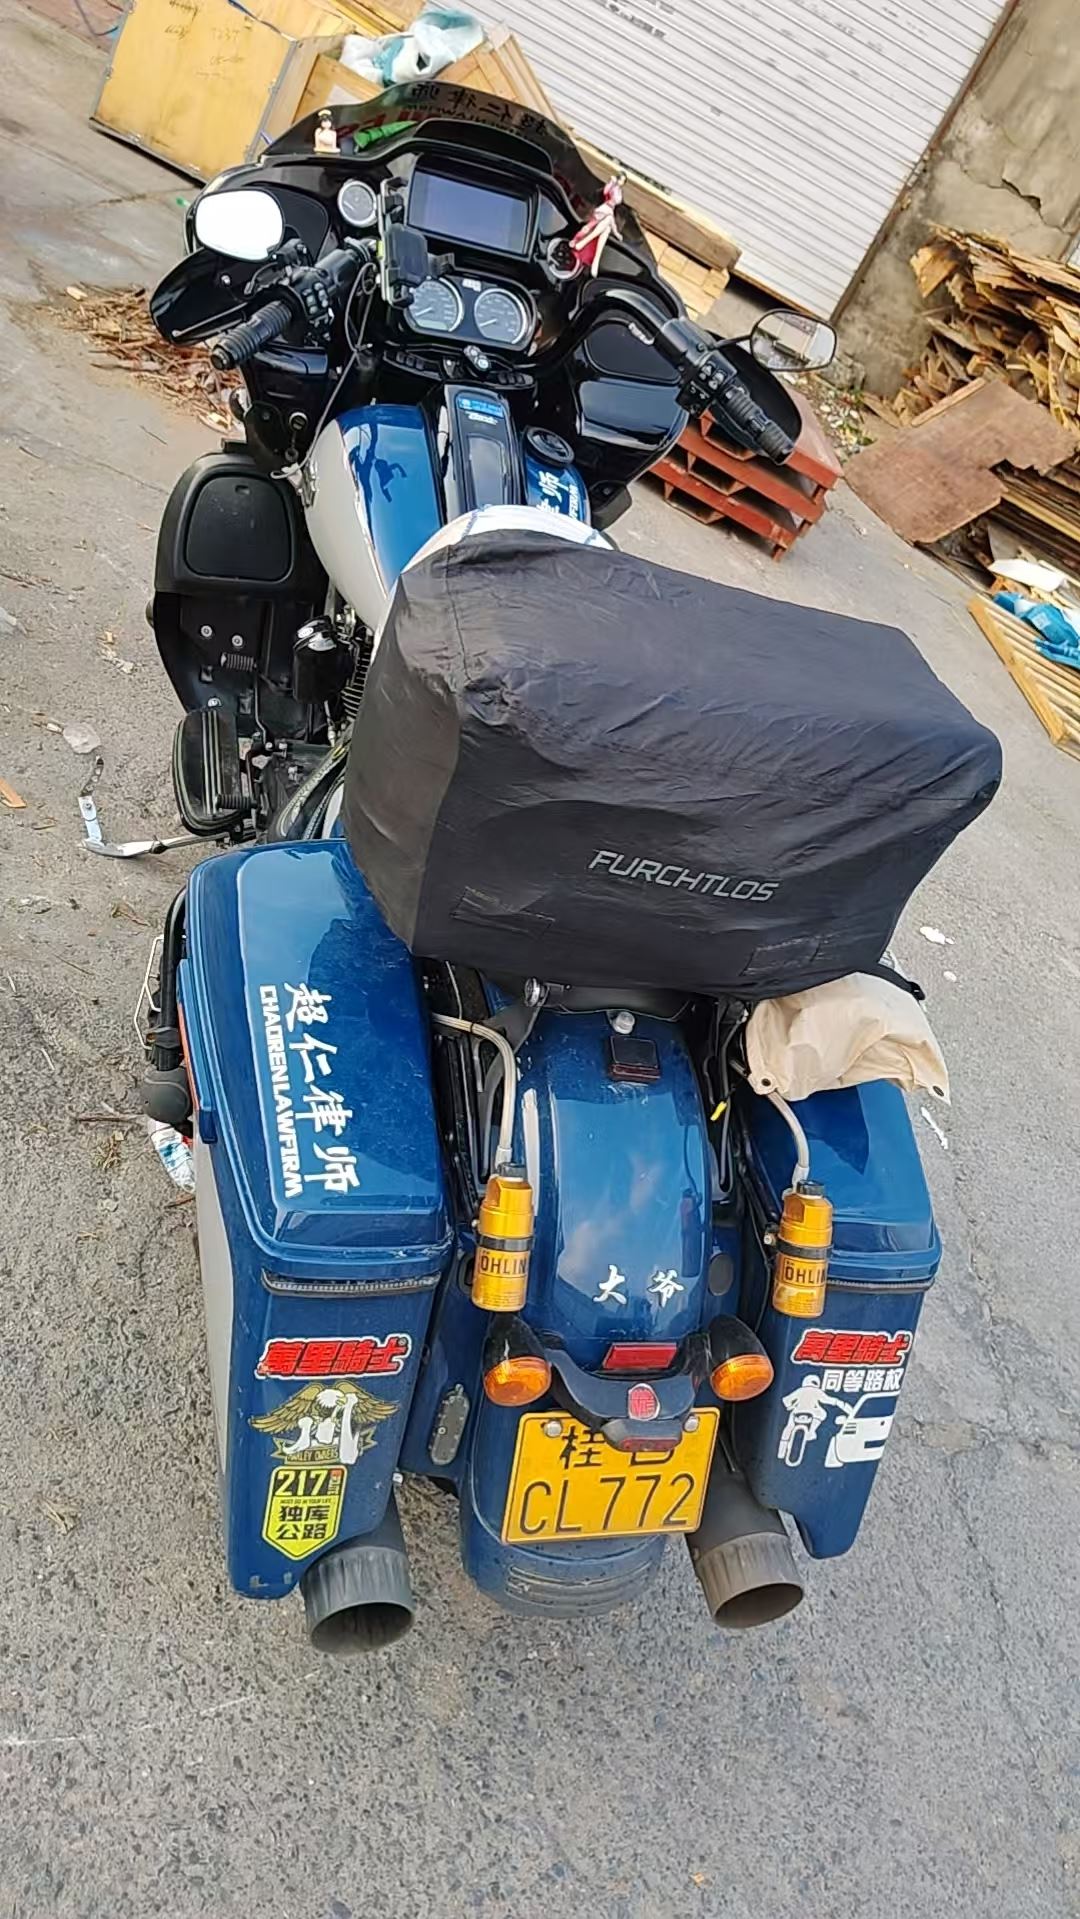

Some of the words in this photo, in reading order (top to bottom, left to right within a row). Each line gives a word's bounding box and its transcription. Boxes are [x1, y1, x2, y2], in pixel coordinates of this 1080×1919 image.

[588, 850, 780, 901] FURCHTLOS
[259, 984, 303, 1199] CHAORENLAWFIRM
[284, 983, 360, 1194] 超仁律师
[821, 1369, 905, 1393] 同等路权
[274, 1469, 329, 1496] 217
[279, 1505, 331, 1522] 独库
[519, 1472, 696, 1535] CL772
[275, 1523, 328, 1540] 公路
